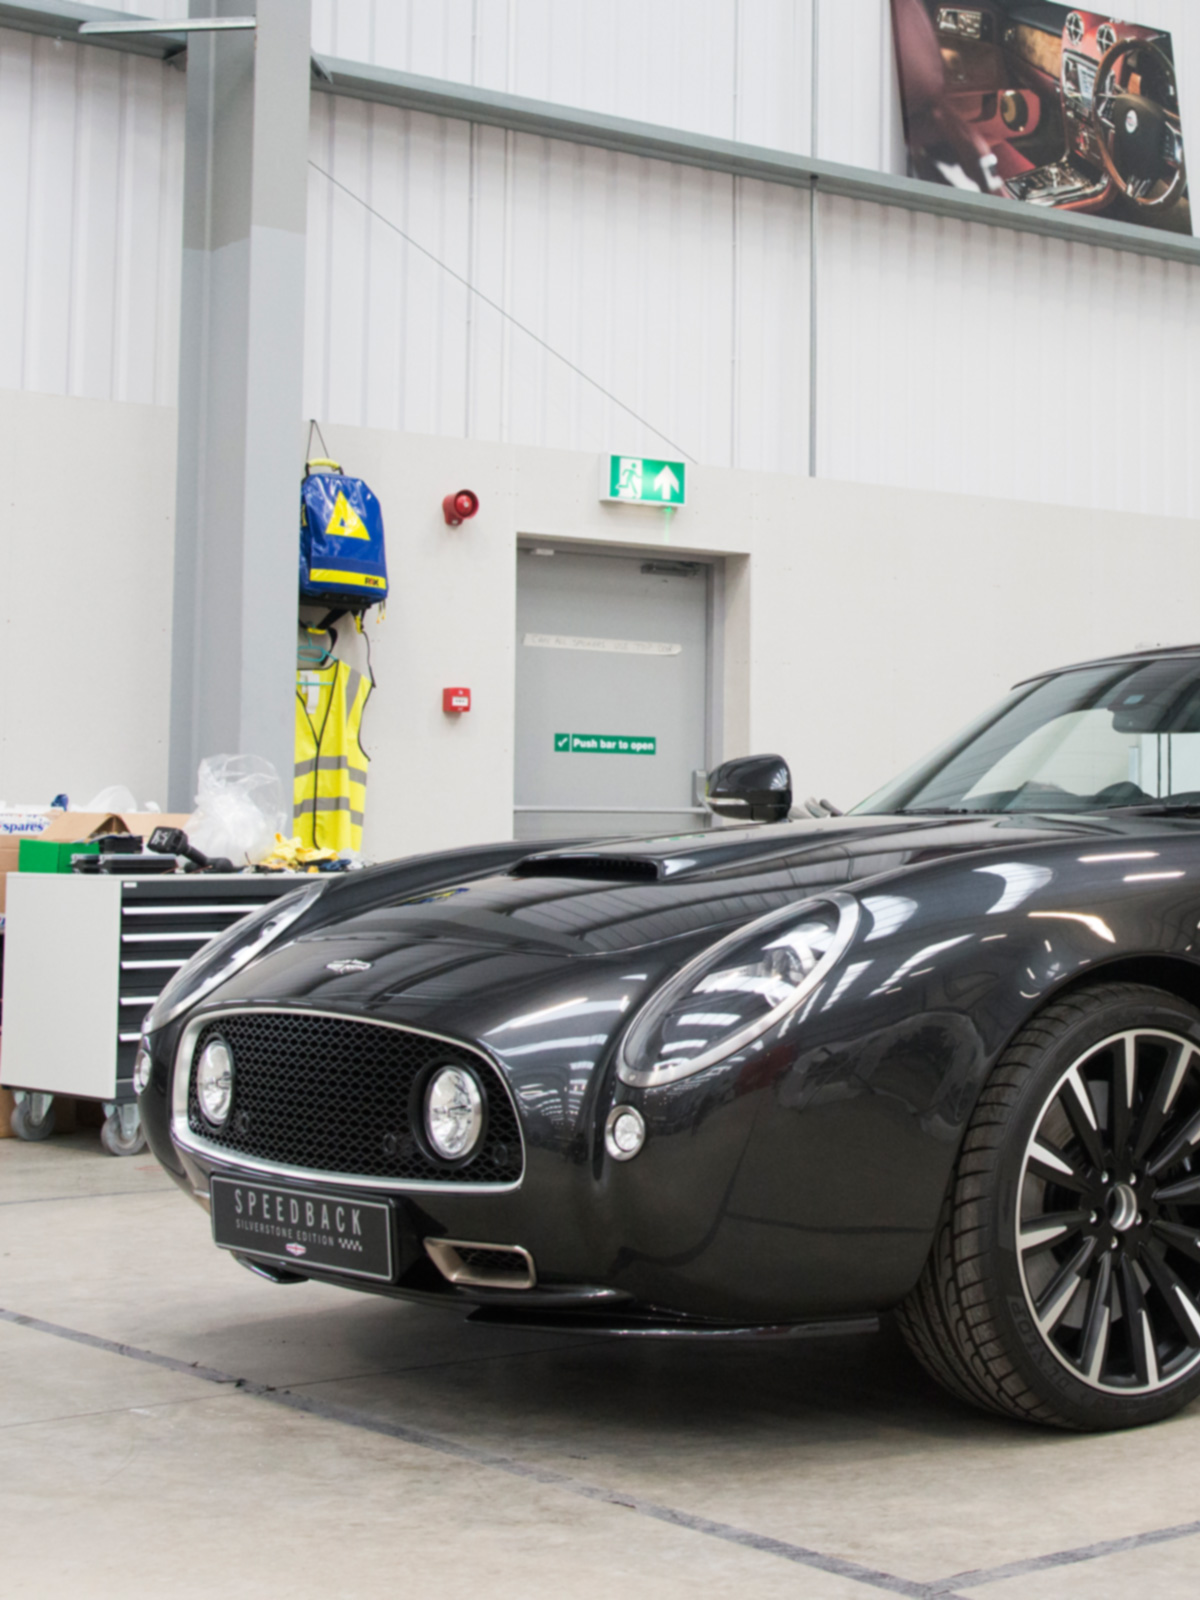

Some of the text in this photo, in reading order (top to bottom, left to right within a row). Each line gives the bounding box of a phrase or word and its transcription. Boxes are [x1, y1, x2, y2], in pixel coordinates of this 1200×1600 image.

[573, 738, 655, 753] Push bar to open
[234, 1188, 362, 1236] SPEEDBACK
[235, 1218, 334, 1247] SILVERSTONE EDITION
